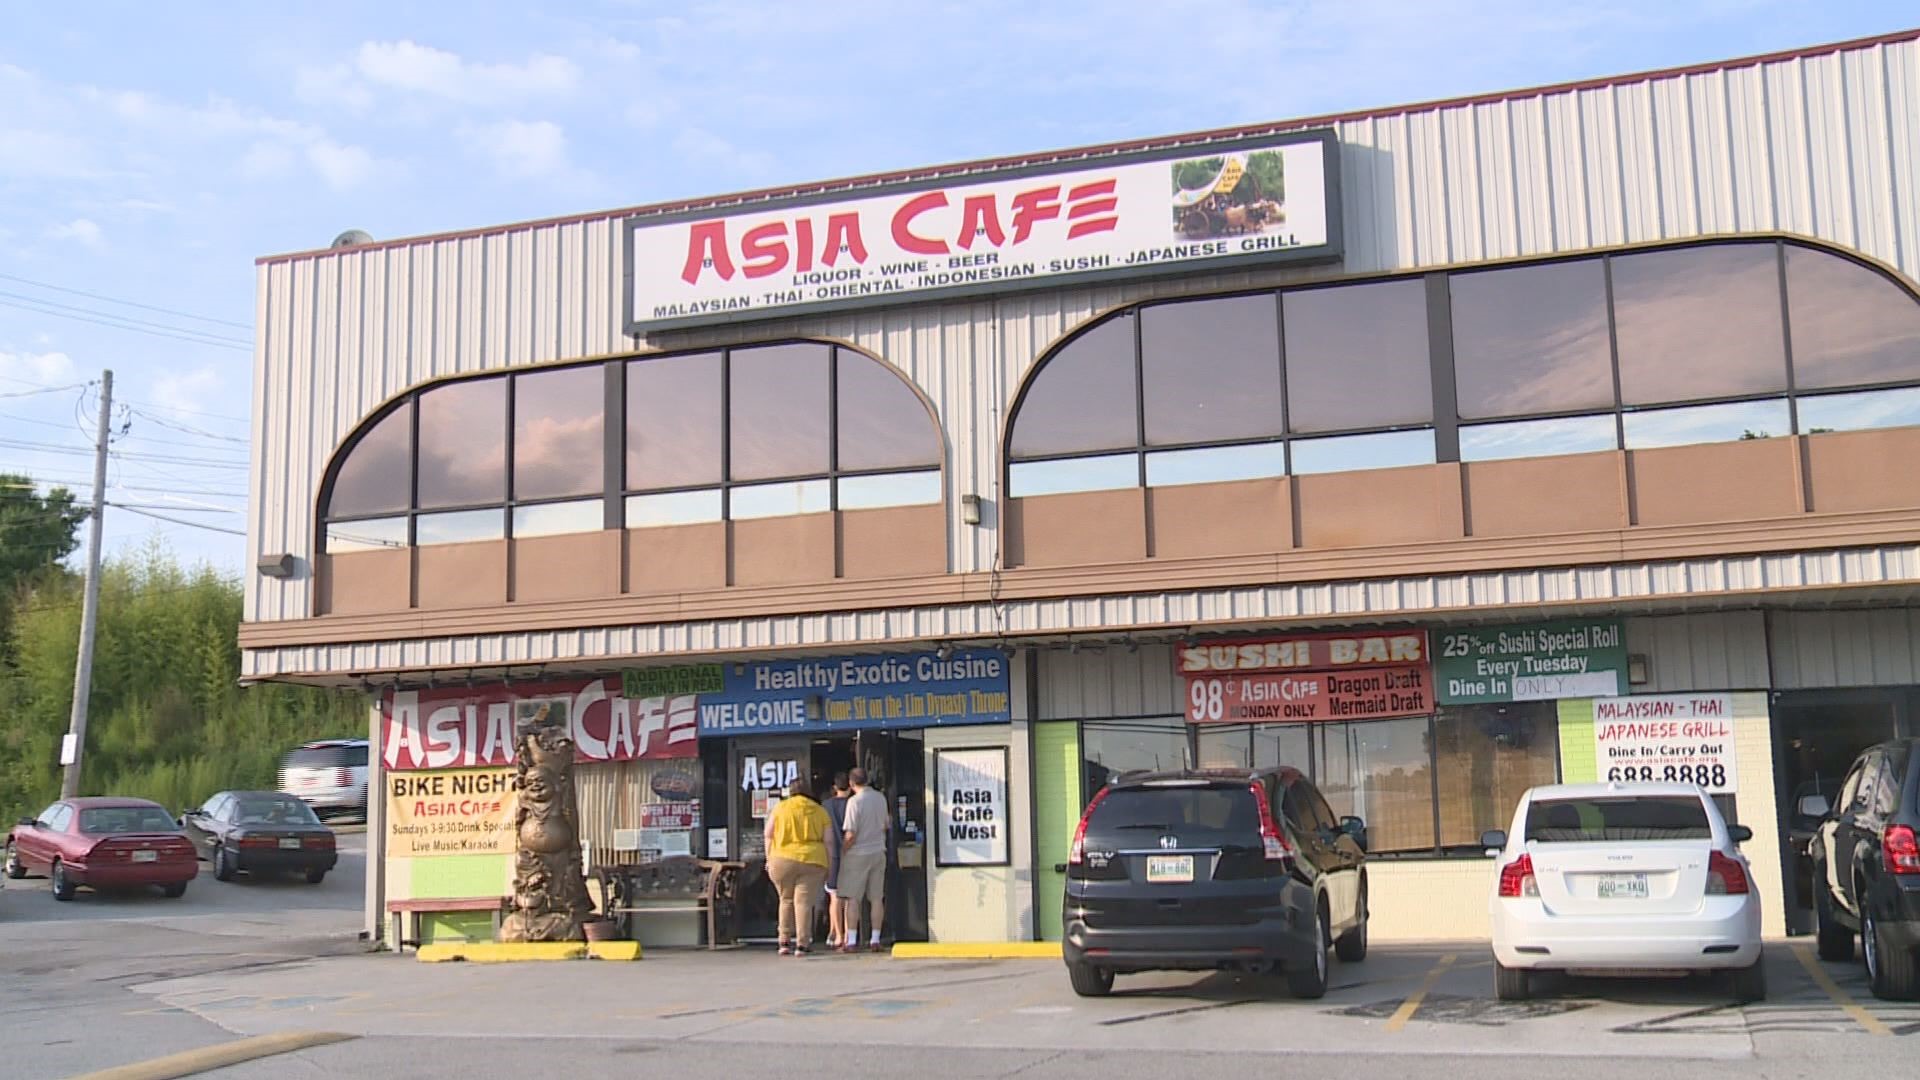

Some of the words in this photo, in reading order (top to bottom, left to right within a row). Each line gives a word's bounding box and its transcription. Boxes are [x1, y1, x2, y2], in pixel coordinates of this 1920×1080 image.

[681, 211, 868, 285] ASIA
[891, 179, 1119, 255] CAFE
[653, 295, 750, 319] MALAYSIAN
[764, 289, 803, 305] THAI
[817, 279, 904, 299] ORIENTAL
[918, 263, 1035, 287] INDONESIAN
[1050, 254, 1110, 272] SUSHI
[1125, 242, 1228, 264] JAPANESE
[1241, 234, 1301, 251] GRILL
[793, 267, 861, 286] LIQUOR
[880, 259, 928, 276] WINE
[948, 251, 999, 270] BEER
[1480, 641, 1496, 655] off
[1499, 630, 1535, 653] Sushi
[1539, 628, 1589, 655] Special
[1592, 625, 1619, 648] Roll
[1183, 640, 1311, 671] SUSHI
[1330, 635, 1422, 664] BAR
[755, 664, 839, 692] Healthy
[841, 661, 910, 686] Exotic
[917, 656, 1001, 682] Cuisine
[1477, 658, 1520, 677] Every
[1523, 654, 1589, 674] Tuesday
[1241, 680, 1280, 702] ASIA
[1281, 678, 1319, 700] CAFE
[1327, 675, 1380, 695] Dragon
[1385, 671, 1422, 690] Draft
[1449, 680, 1486, 696] Dine
[1491, 679, 1507, 694] In
[701, 700, 805, 730] WELCOME
[825, 697, 851, 721] Come
[854, 696, 867, 720] Sit
[870, 698, 883, 719] on
[885, 694, 901, 718] the
[927, 690, 967, 718] Dynasty
[970, 689, 1007, 713] Throne
[1229, 704, 1280, 719] MONDAY
[1284, 703, 1316, 717] ONLY
[1329, 695, 1387, 716] Mermaid
[1391, 693, 1425, 712] Draft
[1598, 701, 1674, 720] MALAYSIAN
[1690, 699, 1723, 716] THAI
[384, 691, 516, 769] ASIA
[571, 679, 698, 760] CAFE
[1599, 722, 1678, 741] JAPANESE
[1682, 721, 1730, 738] GRILL
[1608, 746, 1637, 757] Dine
[1700, 744, 1723, 755] Out
[393, 777, 444, 797] BIKE
[452, 773, 518, 795] NIGHT
[742, 756, 798, 792] ASIA
[1608, 764, 1726, 788] 688-8888
[952, 788, 992, 804] Asia
[414, 800, 456, 817] ASIA
[460, 800, 501, 815] CAFE
[952, 805, 994, 822] Café
[392, 824, 428, 837] Sundays
[458, 820, 480, 833] Drink
[659, 816, 682, 826] WEEK
[949, 824, 998, 840] West
[411, 840, 430, 852] Live
